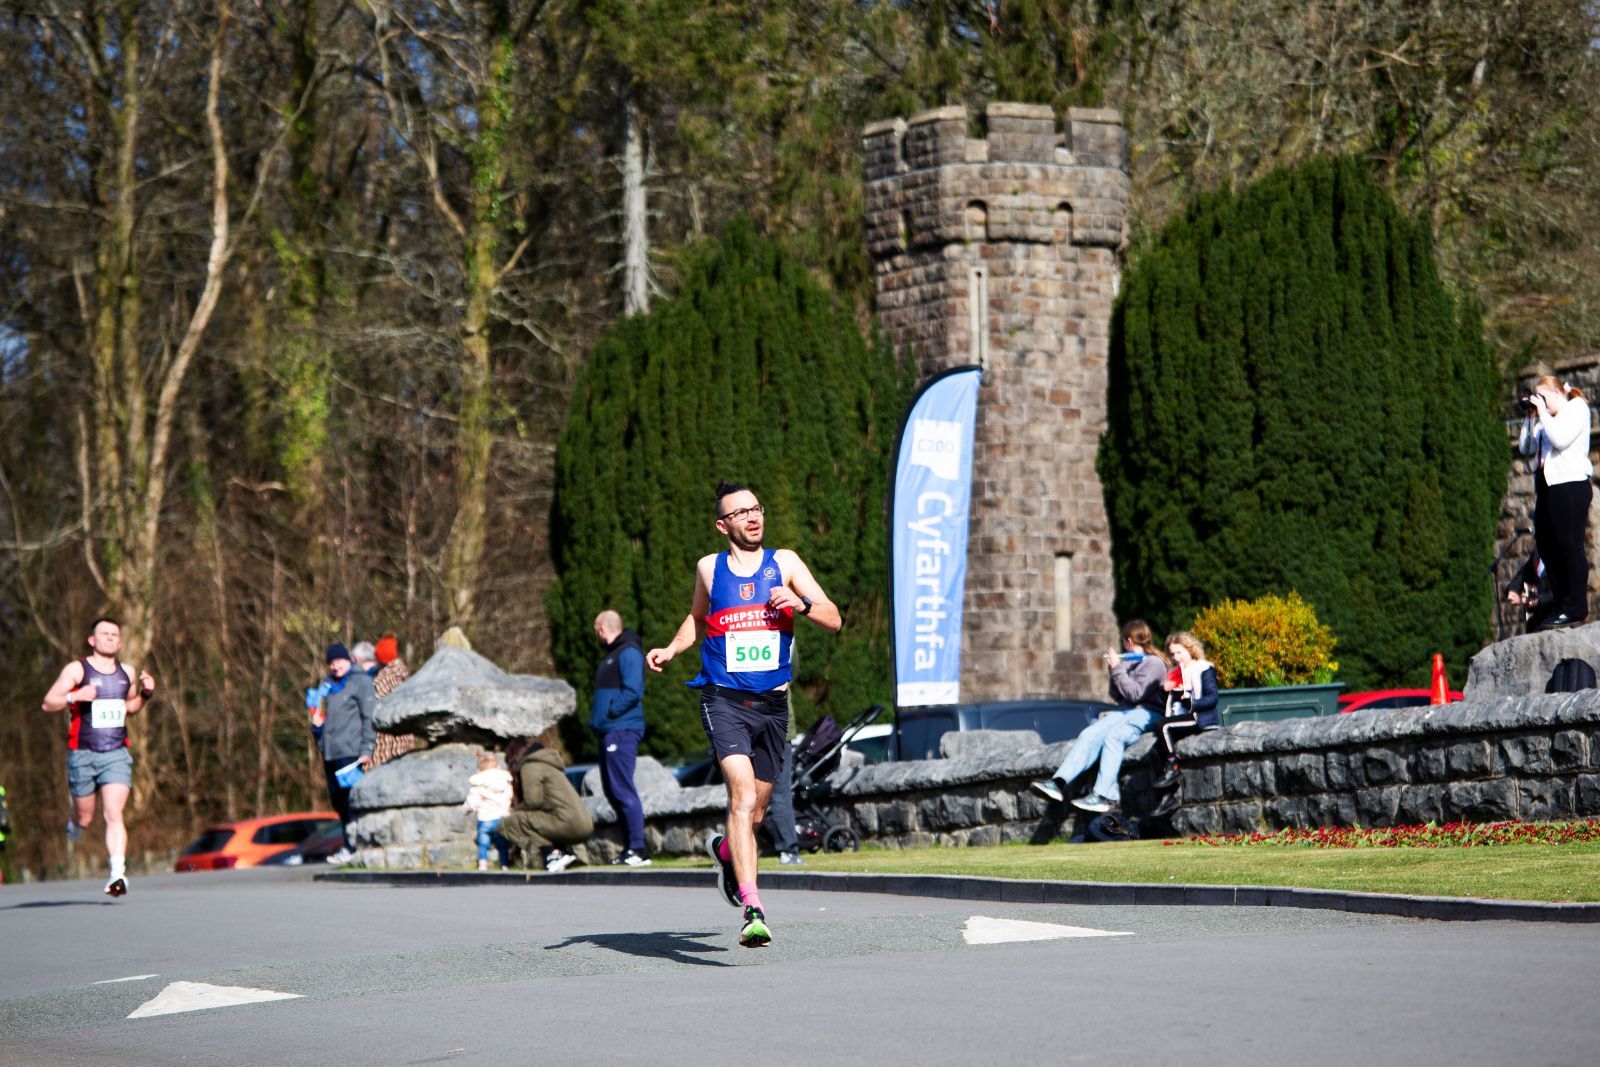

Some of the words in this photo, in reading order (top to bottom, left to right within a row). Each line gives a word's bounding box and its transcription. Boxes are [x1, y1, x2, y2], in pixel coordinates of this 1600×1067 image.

[907, 490, 952, 672] Cyfarthfa
[719, 609, 780, 626] CHEPSTOW
[729, 620, 771, 631] HARRIERS
[735, 645, 772, 662] 506
